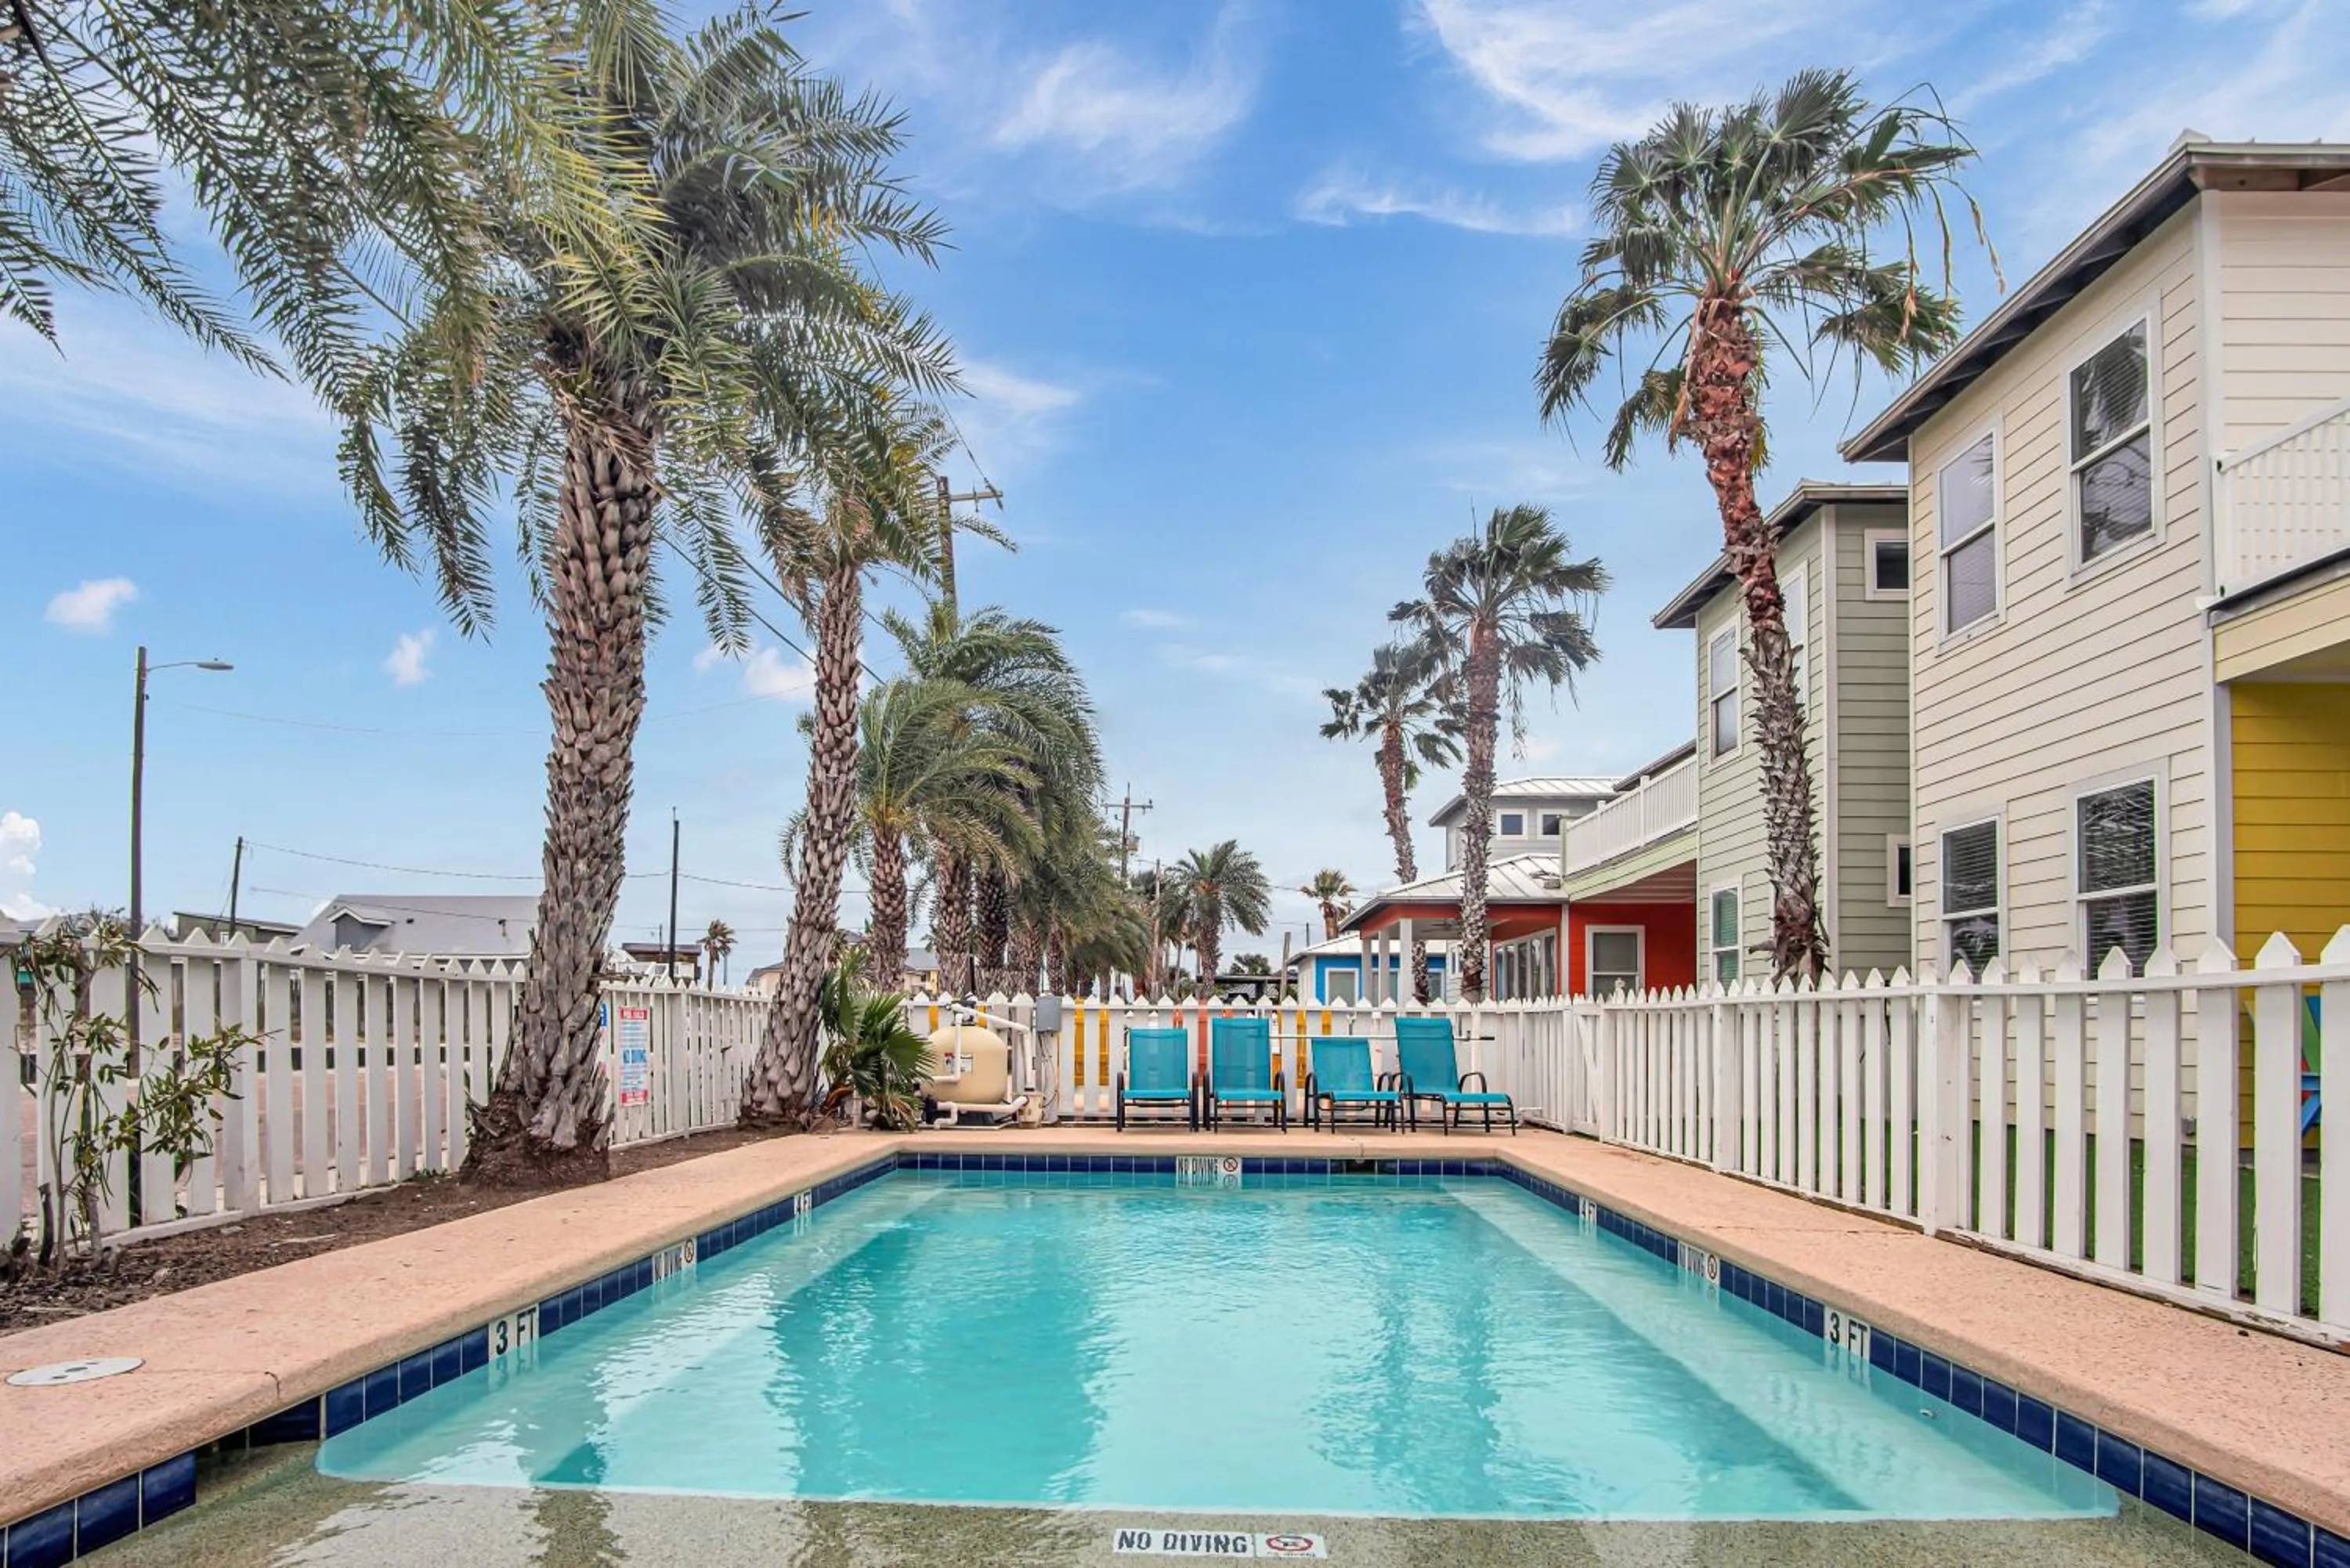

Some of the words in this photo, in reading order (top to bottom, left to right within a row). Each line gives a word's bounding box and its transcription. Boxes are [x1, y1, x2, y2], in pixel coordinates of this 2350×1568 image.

[496, 1320, 508, 1355] 3
[516, 1306, 537, 1346] FT
[1830, 1312, 1840, 1344] 3
[1848, 1318, 1868, 1357] FT
[1118, 1530, 1152, 1550] NO
[1164, 1533, 1247, 1552] DIVING
